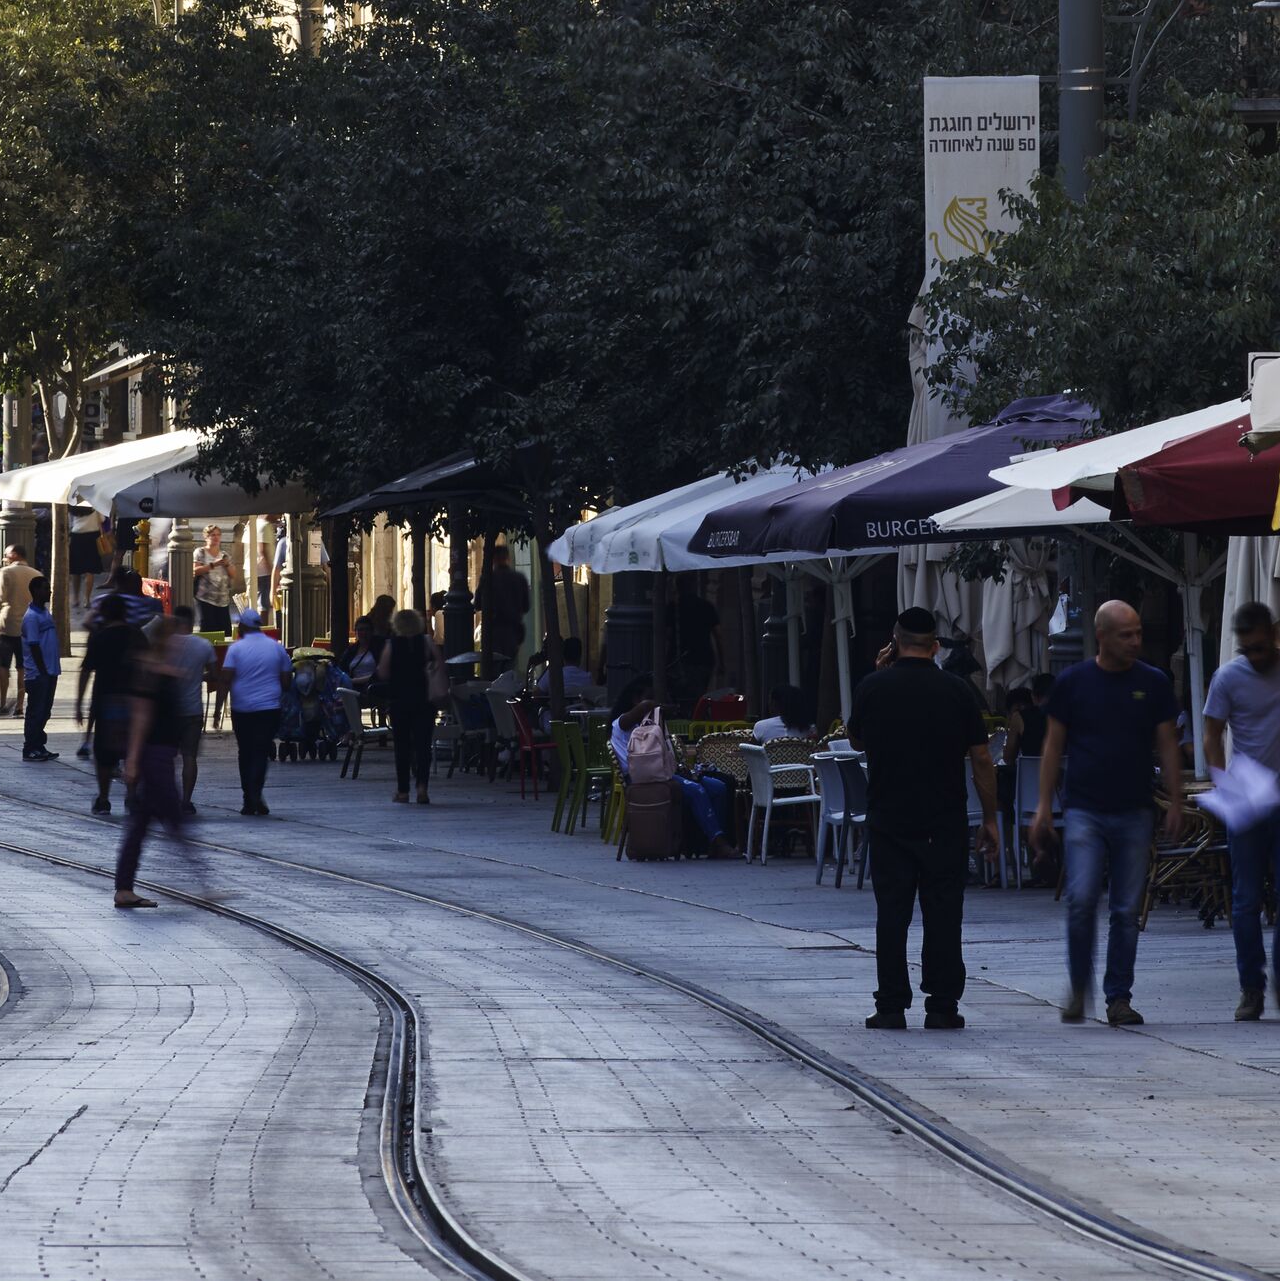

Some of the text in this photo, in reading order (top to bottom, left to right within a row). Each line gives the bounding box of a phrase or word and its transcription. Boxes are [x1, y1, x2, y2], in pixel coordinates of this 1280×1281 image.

[929, 112, 1036, 132] ירושלים חוגגת
[929, 135, 1036, 153] 50 שנה לאיחודה
